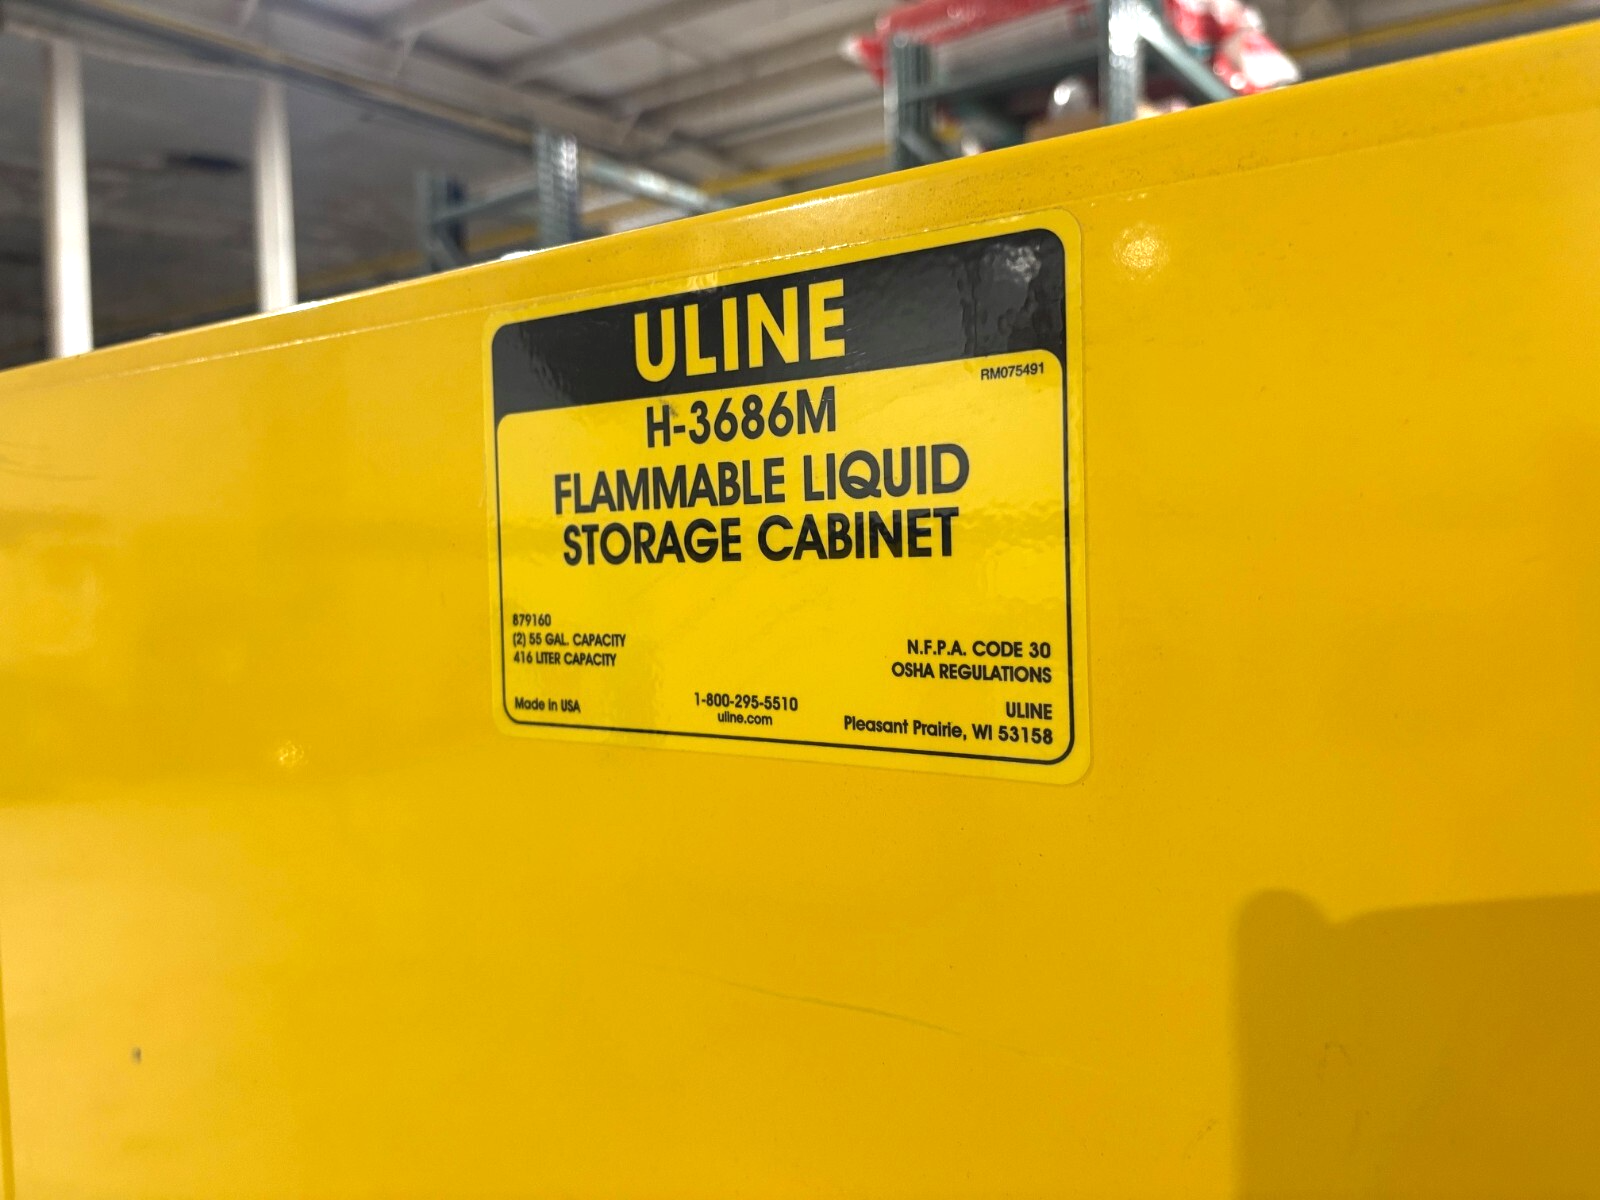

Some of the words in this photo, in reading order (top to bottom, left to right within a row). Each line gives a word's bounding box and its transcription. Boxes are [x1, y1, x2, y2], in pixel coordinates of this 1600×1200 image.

[633, 279, 846, 382] ULINE
[980, 362, 1046, 381] RM075491
[646, 386, 836, 448] H-3686M
[554, 457, 785, 516] FLAMMABLE
[803, 443, 970, 502] LIQUID
[563, 517, 742, 566] STORAGE
[758, 507, 959, 561] CABINET
[512, 613, 552, 627] 879160
[512, 632, 526, 648] (2)
[528, 633, 542, 646] 55
[545, 633, 569, 646] GAL.
[573, 633, 626, 648] CAPACITY
[907, 639, 967, 656] N.F.P.A.
[972, 640, 1023, 658] CODE
[1029, 642, 1051, 659] 30
[513, 651, 533, 664] 416
[536, 652, 561, 665] LITER
[564, 652, 617, 667] CAPACITY
[891, 662, 934, 679] OSHA
[939, 664, 1052, 684] REGULATIONS
[514, 697, 545, 711] Made
[548, 698, 557, 711] in
[560, 699, 581, 713] USA
[694, 691, 799, 712] 1-800-295-5510
[1005, 701, 1053, 720] ULINE
[718, 710, 773, 726] uline.com
[844, 715, 908, 734] Pleasant
[913, 719, 967, 741] Prairie,
[972, 724, 993, 741] WI
[998, 726, 1053, 745] 53158
